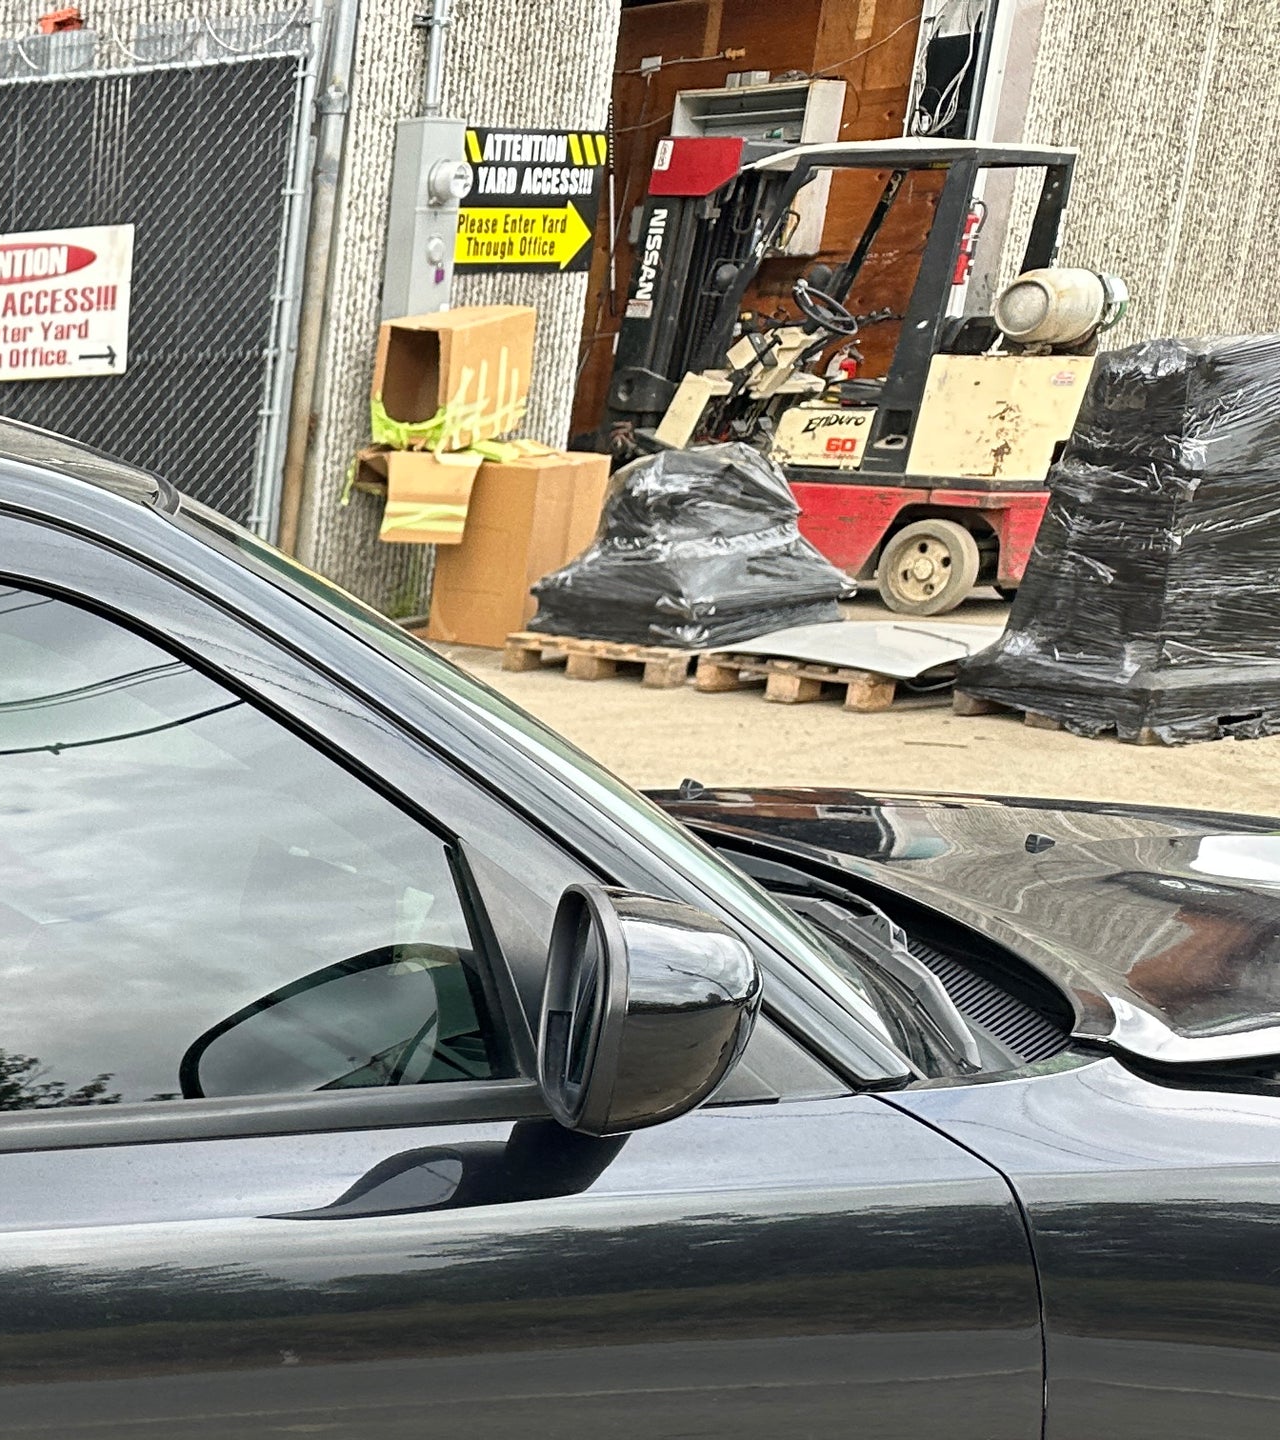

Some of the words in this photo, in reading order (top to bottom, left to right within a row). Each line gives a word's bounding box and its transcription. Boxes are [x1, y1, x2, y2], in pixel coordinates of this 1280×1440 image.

[483, 134, 568, 162] ATTENTION
[478, 167, 517, 194] YARD
[520, 167, 593, 194] ACCESS!!!
[457, 214, 497, 234] Please
[503, 214, 536, 234] Enter
[541, 214, 568, 234] Yard
[466, 237, 514, 259] Through
[519, 237, 556, 256] Office
[635, 208, 669, 300] NISSAN
[2, 285, 118, 318] ACCESS!!!
[40, 319, 89, 341] Yard
[825, 438, 857, 452] 60
